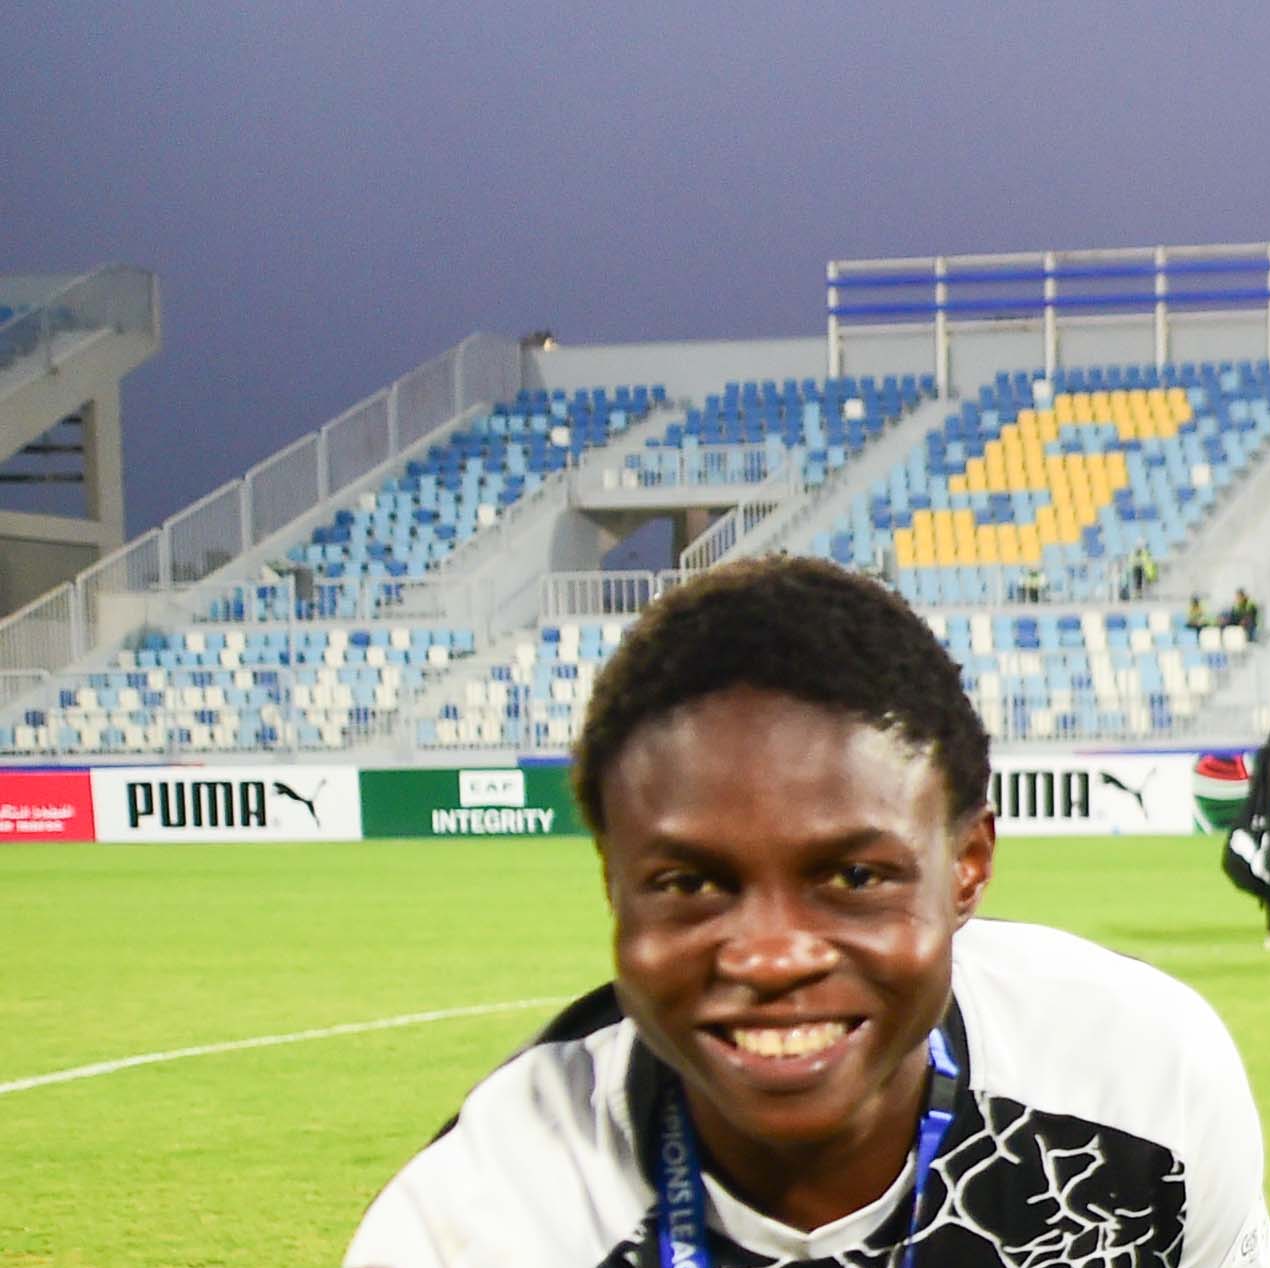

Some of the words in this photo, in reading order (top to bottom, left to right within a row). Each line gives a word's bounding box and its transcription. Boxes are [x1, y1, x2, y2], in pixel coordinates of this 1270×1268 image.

[127, 781, 266, 828] PUMA
[991, 770, 1089, 818] MA
[432, 807, 554, 834] INTEGRITY
